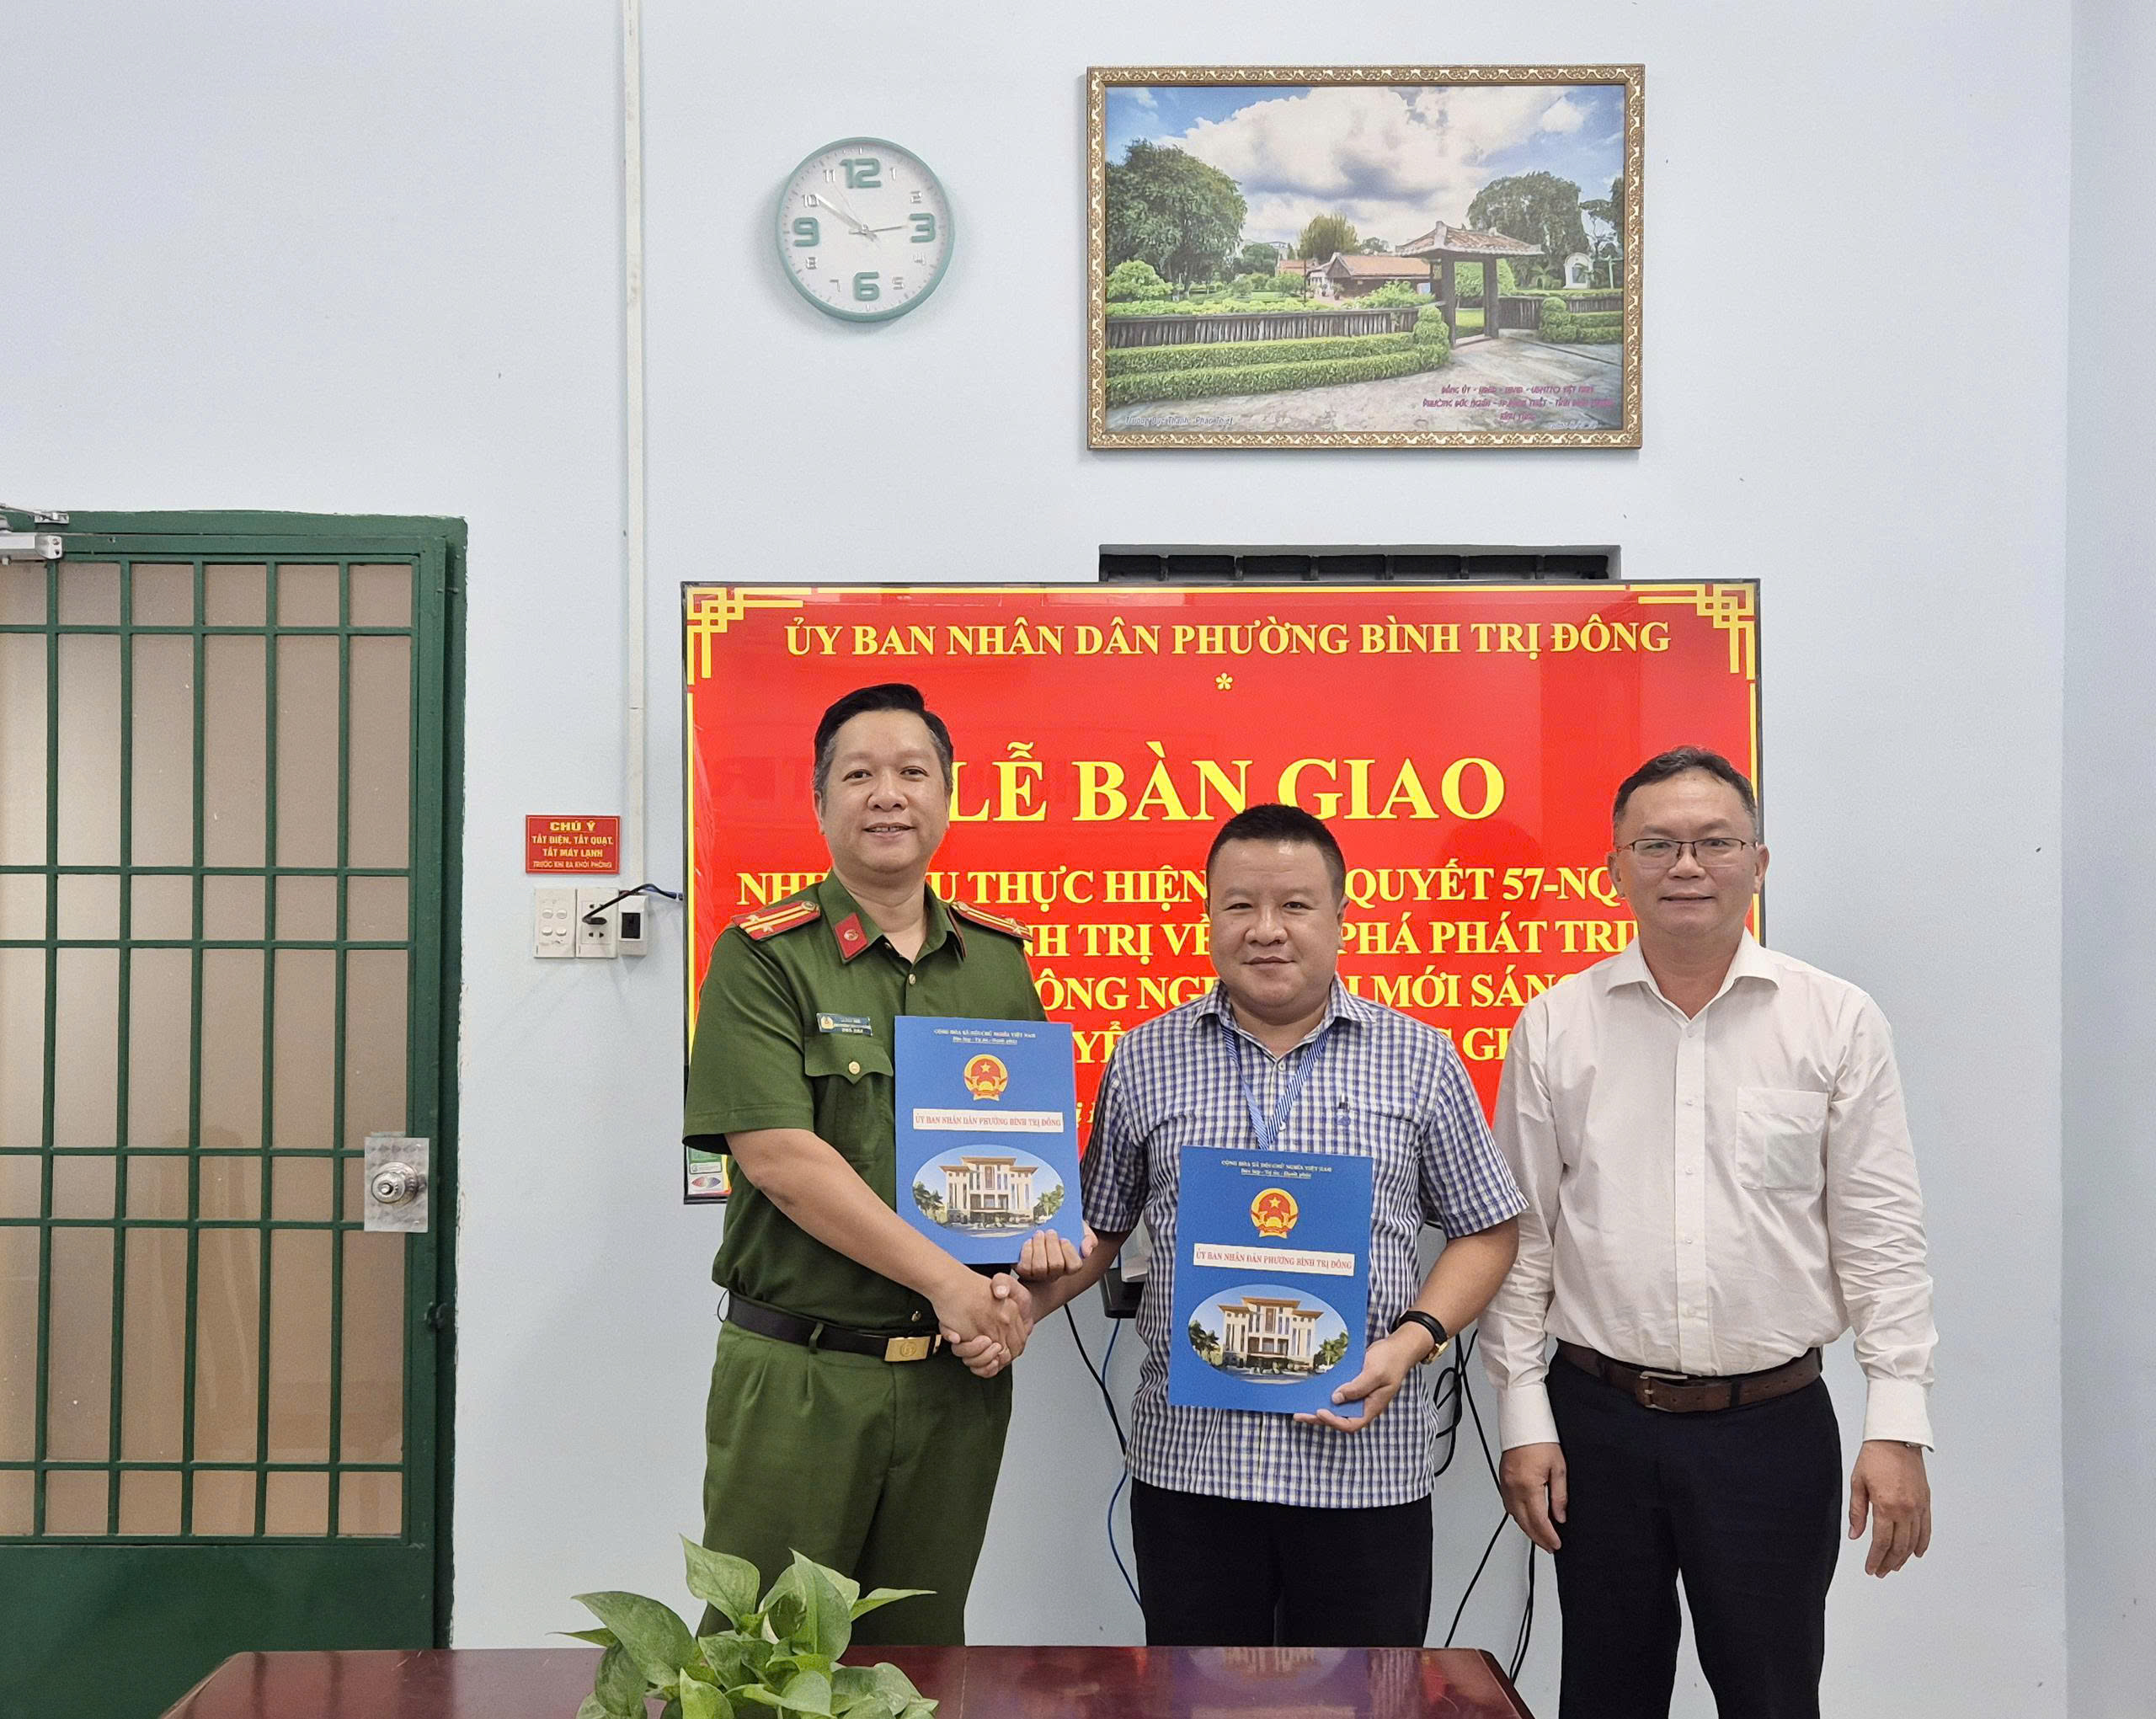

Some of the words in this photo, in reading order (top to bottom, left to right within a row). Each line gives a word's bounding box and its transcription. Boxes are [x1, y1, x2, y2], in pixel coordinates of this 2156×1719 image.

[840, 158, 881, 189] 12
[793, 217, 819, 247] 9
[909, 213, 936, 243] 3
[853, 271, 879, 302] 6
[784, 617, 843, 655] ỦY
[851, 626, 936, 655] BAN
[946, 617, 1065, 655] NHÂN
[1074, 616, 1161, 654] DÂN
[1171, 619, 1349, 654] PHƯỜNG
[1358, 616, 1462, 653] BÌNH
[1470, 624, 1542, 659] TRỊ
[1550, 614, 1671, 653] ĐÔNG
[949, 741, 1047, 821] LỄ
[1071, 741, 1253, 821] BÀN
[1278, 757, 1506, 820] GIAO
[550, 820, 581, 831] CHÚ
[586, 820, 595, 831] Ý
[967, 865, 1093, 912] THỰC
[1102, 864, 1208, 911] HIỆN
[1344, 858, 1494, 909] QUYẾT
[1078, 924, 1153, 964] TRỊ
[1337, 911, 1422, 954] PHÁ
[1428, 910, 1547, 954] PHÁT
[1555, 920, 1638, 953] TRI
[1034, 968, 1129, 1011] ÔNG
[1371, 965, 1462, 1007] MỚI
